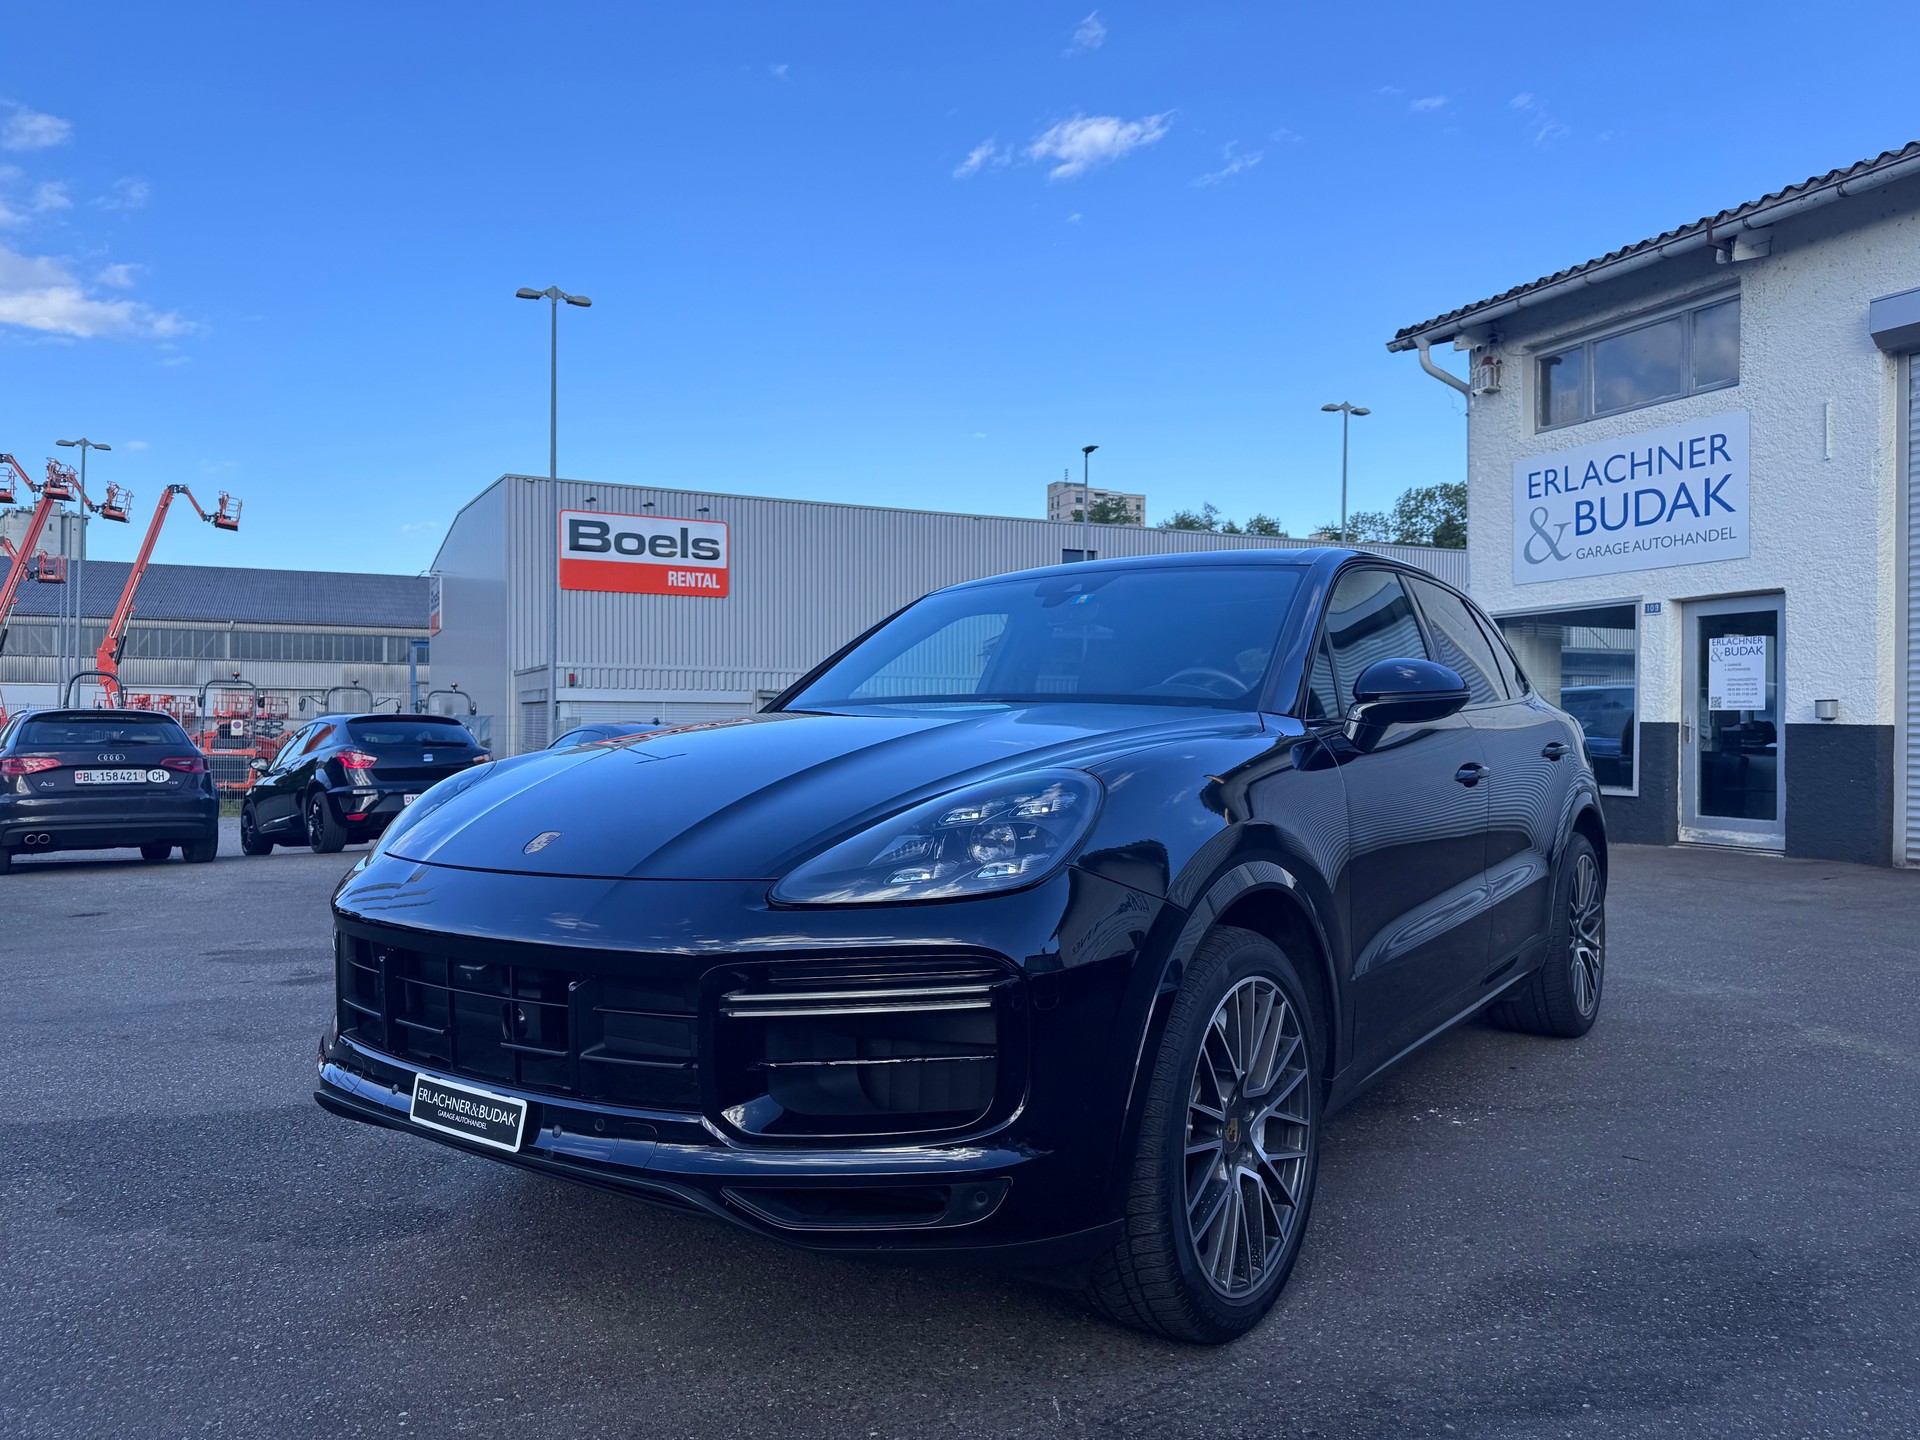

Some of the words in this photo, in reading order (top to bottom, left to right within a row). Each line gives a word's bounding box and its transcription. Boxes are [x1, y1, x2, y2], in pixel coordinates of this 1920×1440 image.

[1528, 433, 1733, 500] ERLACHNER
[1523, 506, 1572, 565] &
[1575, 473, 1737, 537] BUDAK
[569, 518, 721, 561] Boels
[1576, 541, 1630, 560] GARAGE
[1632, 526, 1737, 552] AUTOHANDEL
[667, 570, 720, 589] RENTAL
[1644, 603, 1659, 613] 109
[1711, 636, 1763, 646] ERLACHNER
[1710, 647, 1724, 662] &
[1724, 645, 1764, 656] BUDAK
[152, 771, 165, 781] CH
[437, 1109, 456, 1121] GARAGE
[455, 1115, 487, 1130] AUTOHANDEL
